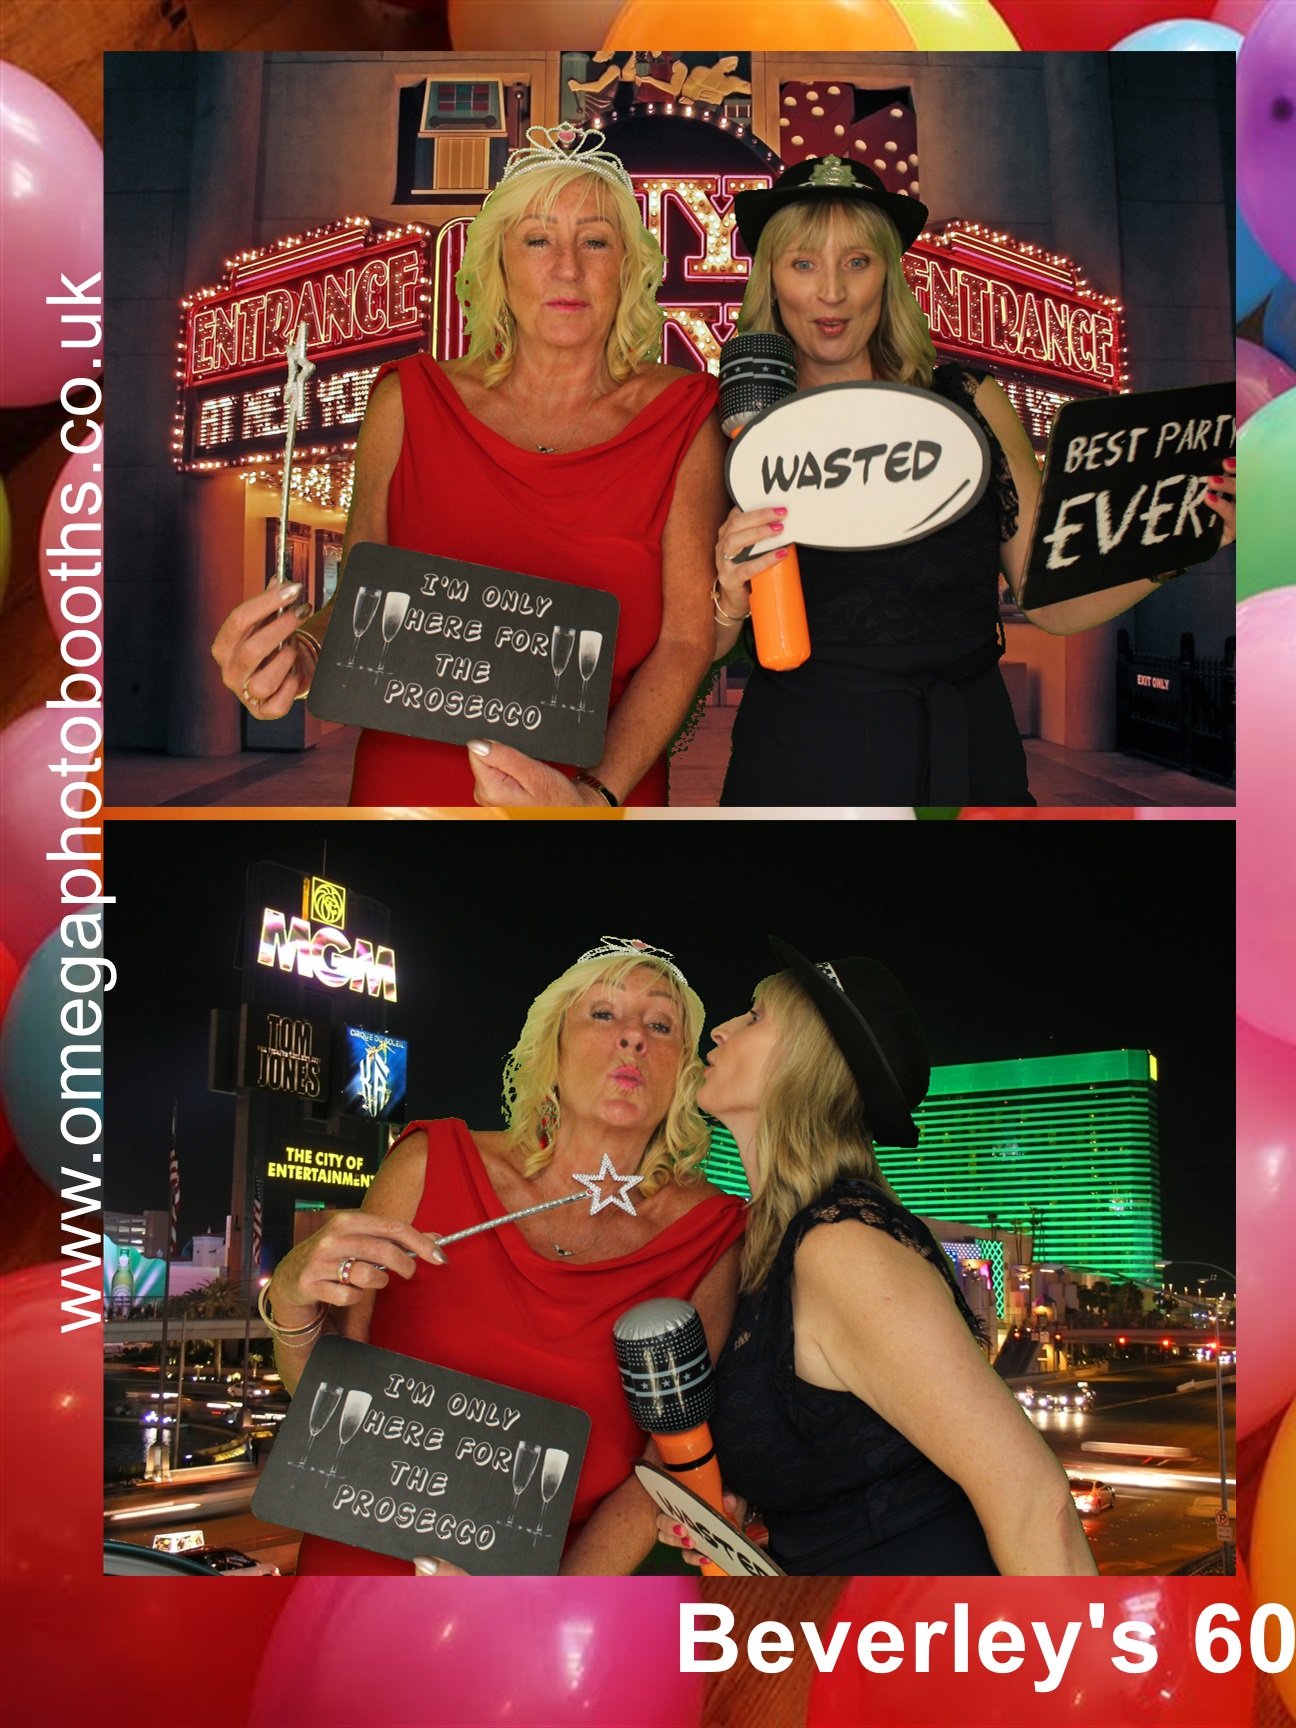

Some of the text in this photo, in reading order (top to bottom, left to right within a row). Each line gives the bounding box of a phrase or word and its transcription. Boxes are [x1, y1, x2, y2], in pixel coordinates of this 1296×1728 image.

[191, 250, 420, 374] ENTRANCE
[761, 440, 943, 495] WASTED
[1064, 427, 1149, 473] BEST
[1042, 474, 1217, 570] EVER
[420, 573, 553, 617] I'M ONLY
[404, 608, 549, 657] HERE FOR
[435, 653, 490, 684] THE
[1136, 674, 1170, 691] EXIT ONLY
[383, 679, 542, 730] PROSECCO
[257, 907, 398, 1003] MGM
[266, 1013, 313, 1056] TOM
[257, 1051, 321, 1097] JONES
[285, 1146, 364, 1171] THE CITY OF
[384, 1374, 521, 1431] I'M ONLY
[362, 1409, 512, 1472] HERE FOR
[391, 1460, 448, 1496] THE
[332, 1484, 496, 1551] PROSECCO
